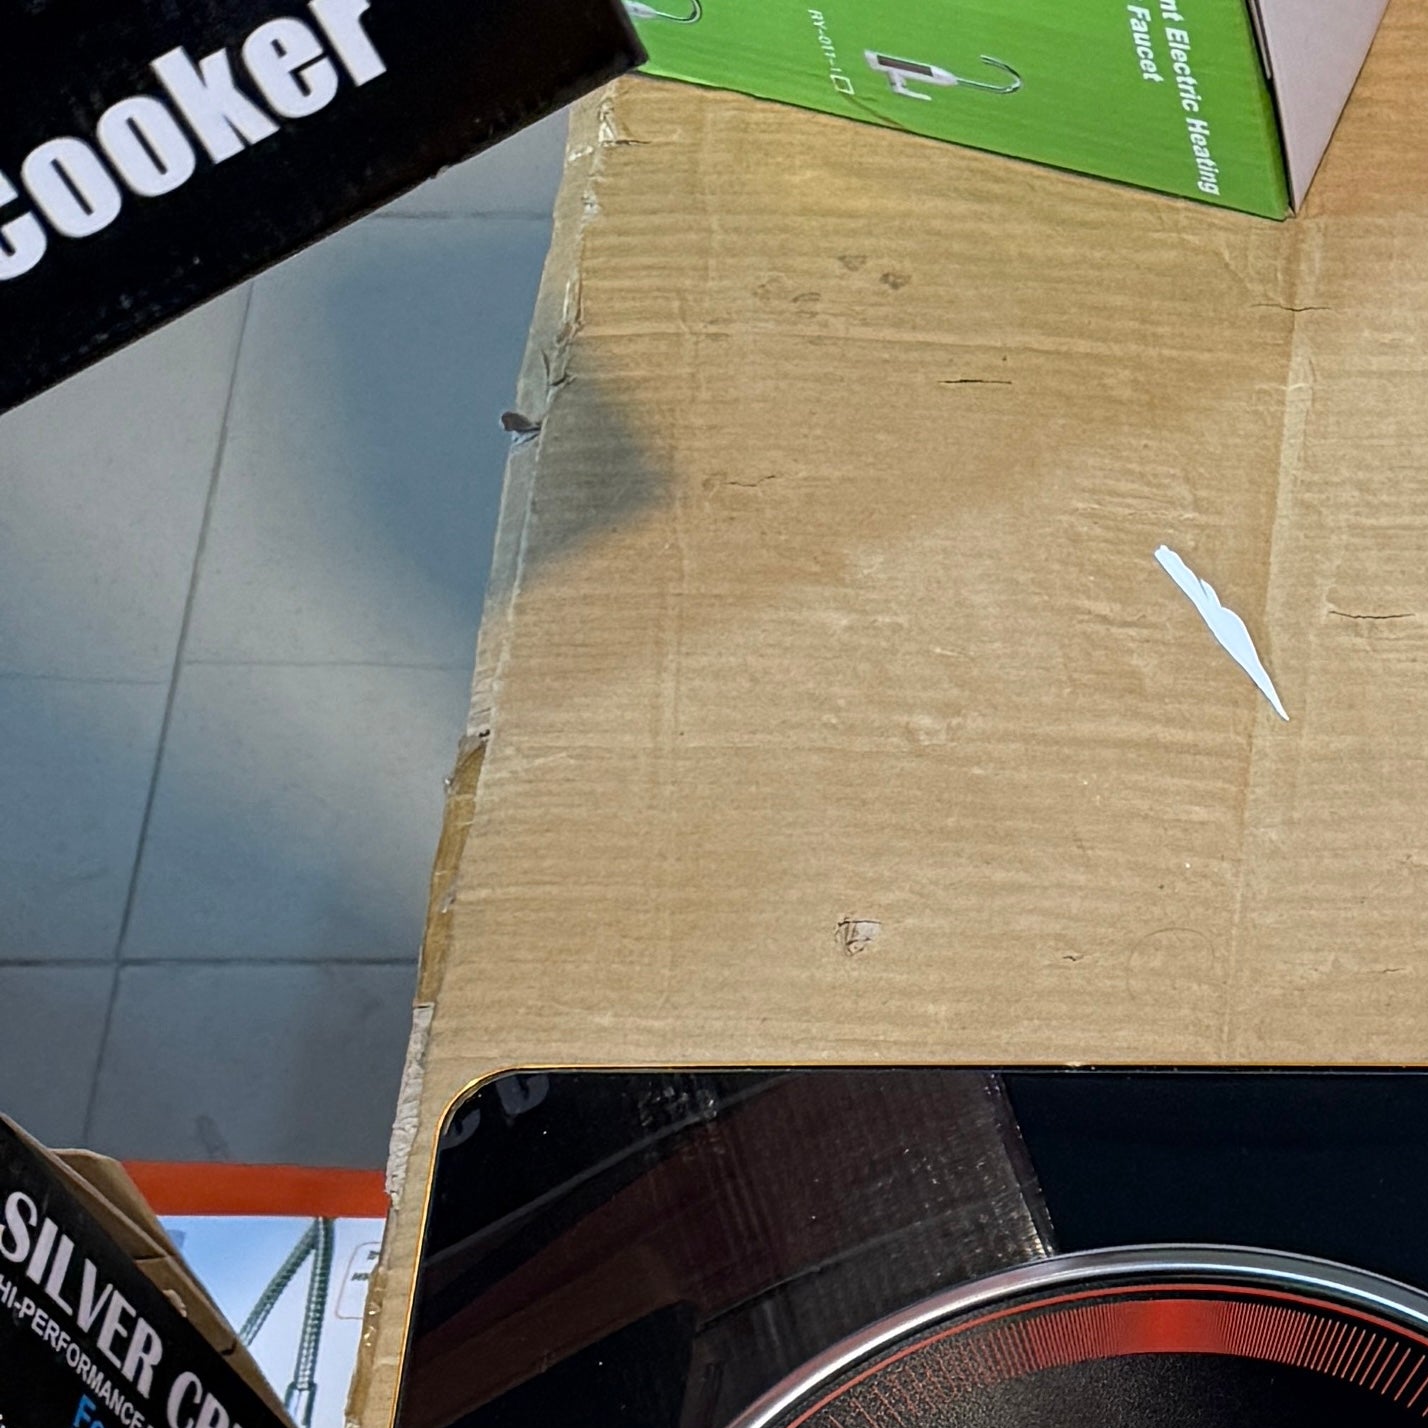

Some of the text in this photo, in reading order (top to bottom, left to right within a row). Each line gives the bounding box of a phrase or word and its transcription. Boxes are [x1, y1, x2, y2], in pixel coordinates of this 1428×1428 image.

[1127, 5, 1164, 82] Faucet
[1165, 27, 1202, 112] Electric
[1186, 117, 1220, 196] Heating
[0, 1191, 163, 1399] SILVER
